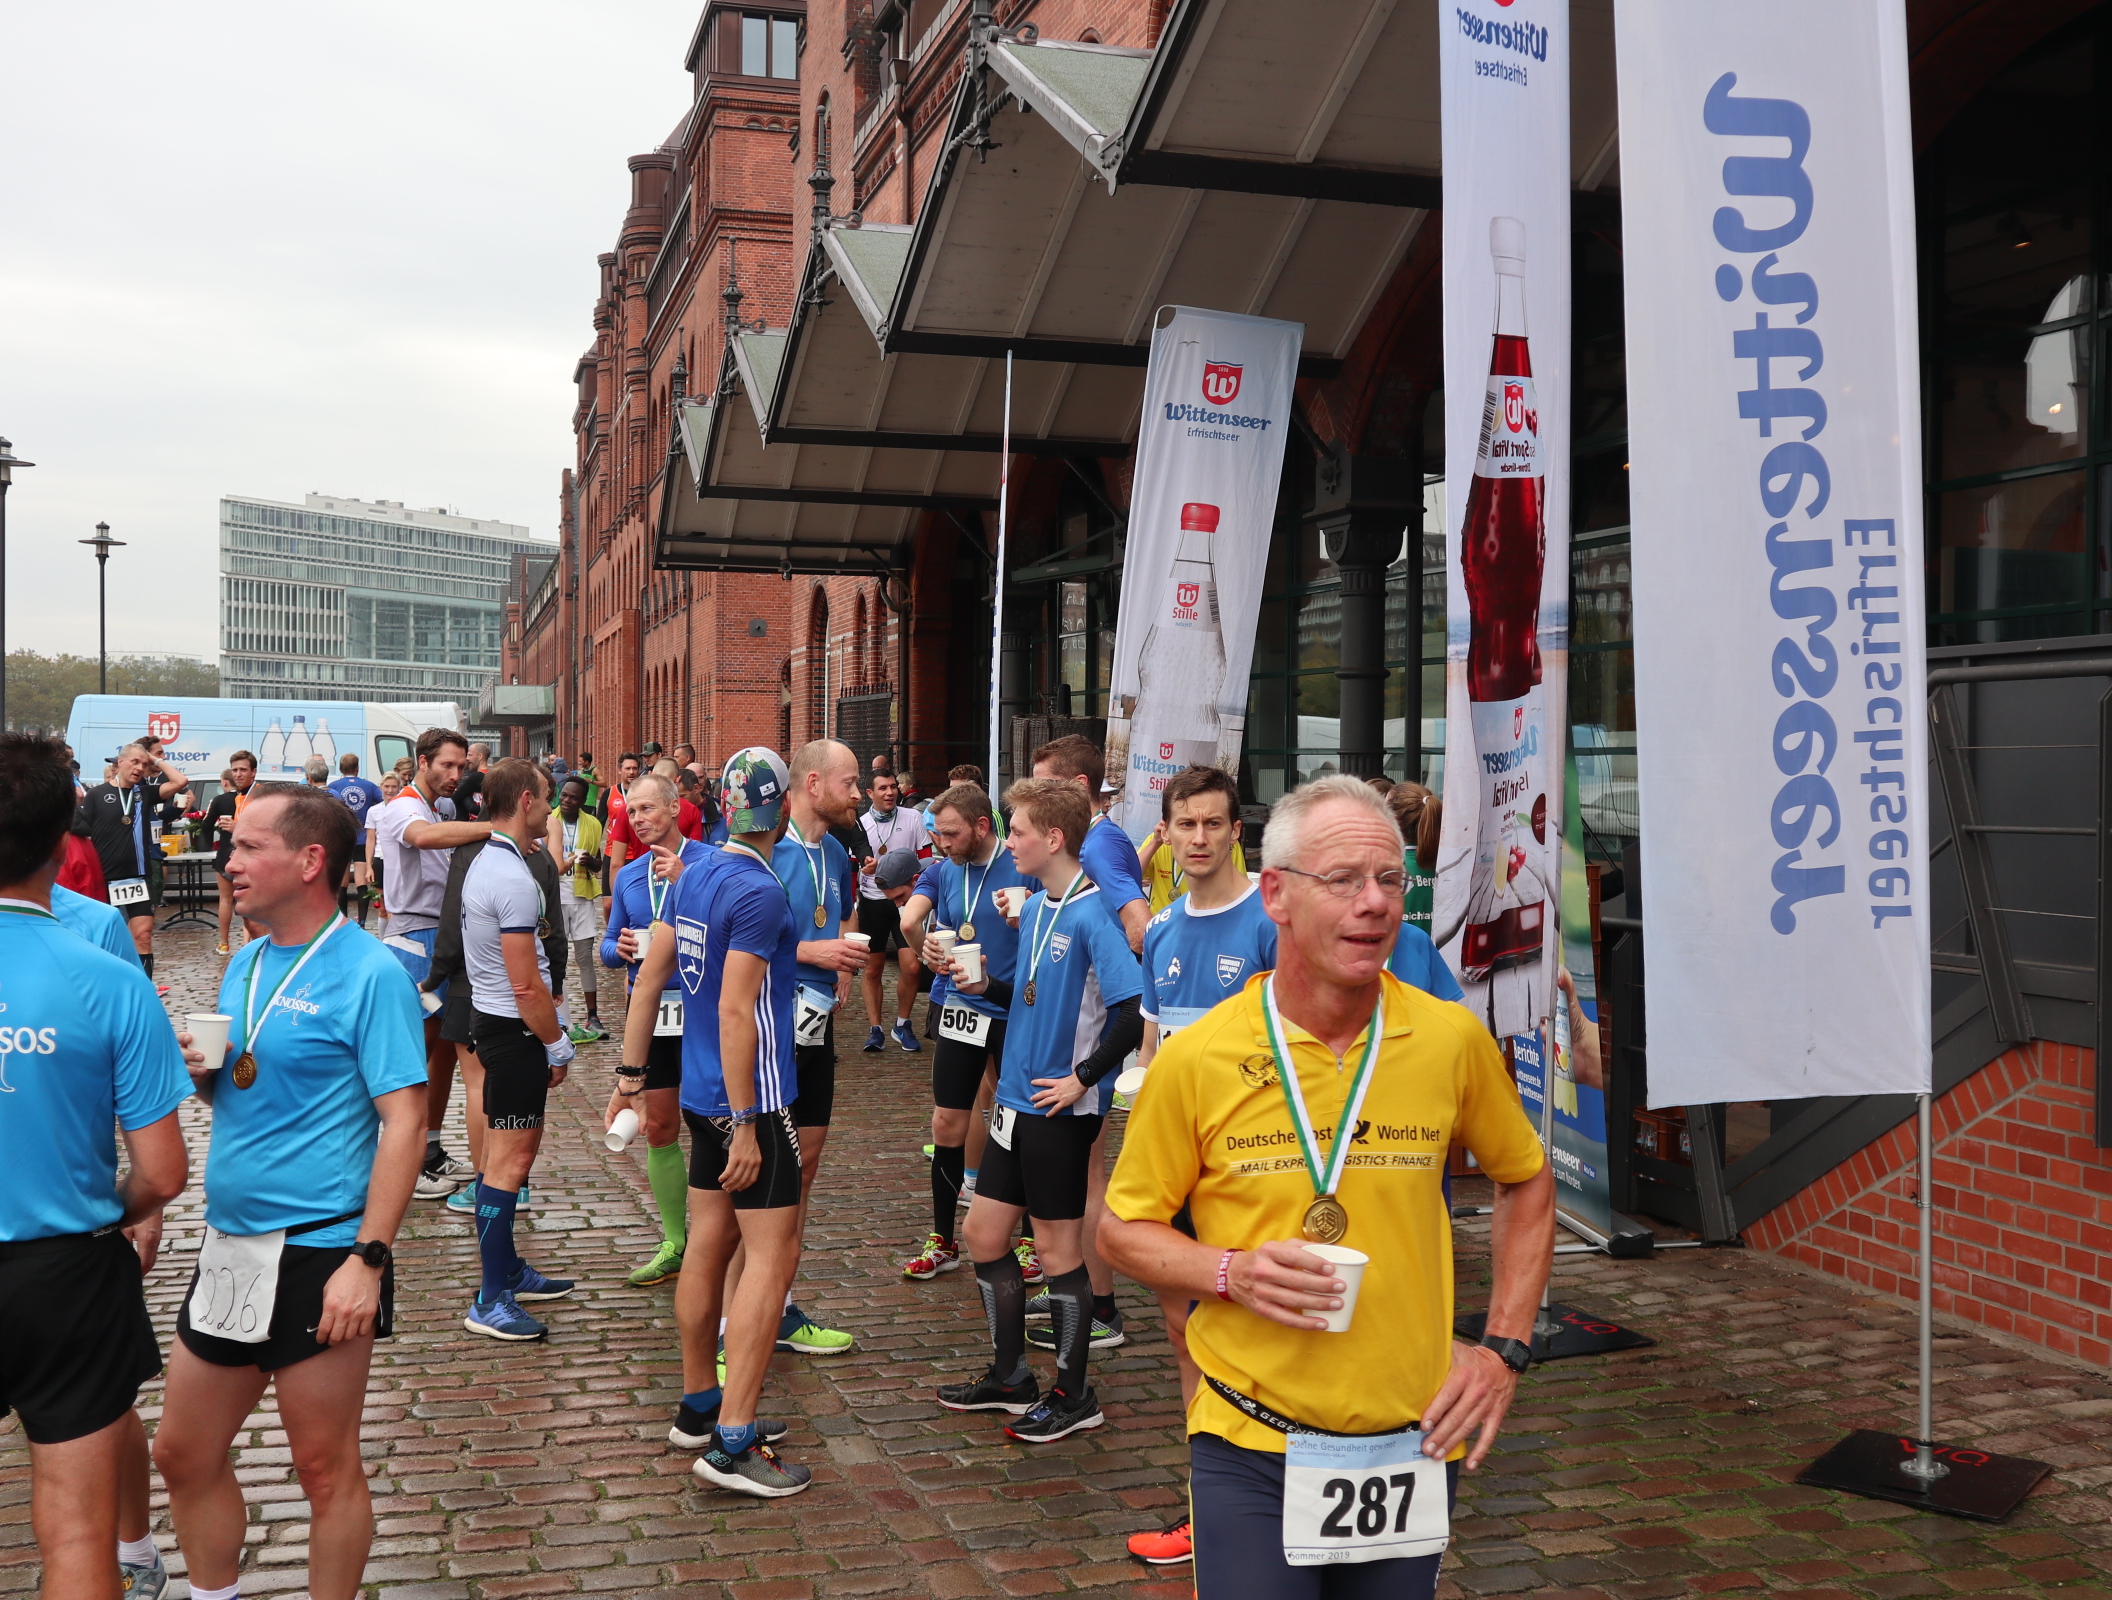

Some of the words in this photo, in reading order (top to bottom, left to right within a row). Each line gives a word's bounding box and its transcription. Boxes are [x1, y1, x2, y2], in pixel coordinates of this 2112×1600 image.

[1205, 373, 1238, 399] W
[1164, 402, 1272, 430] Wittenseer
[1187, 427, 1240, 442] Erfrischtseer
[1172, 607, 1198, 621] Stille
[1132, 752, 1190, 775] Wittens
[113, 884, 144, 900] 1179
[274, 995, 320, 1015] KNOSSOS
[943, 1008, 979, 1034] 505
[1227, 1129, 1296, 1150] Deutsche
[1313, 1126, 1333, 1140] ost
[1376, 1125, 1417, 1141] World
[1421, 1127, 1441, 1142] Net
[1240, 1162, 1270, 1173] MAIL
[1274, 1159, 1307, 1170] EXPR
[1344, 1155, 1387, 1165] GISTICS
[1391, 1156, 1432, 1166] FINANCE
[199, 1267, 261, 1333] 226
[1320, 1442, 1367, 1453] Gesundheit
[1369, 1440, 1396, 1453] gewinnt
[1320, 1472, 1416, 1538] 287
[1290, 1551, 1325, 1560] Sommer
[1328, 1551, 1350, 1560] 2019
